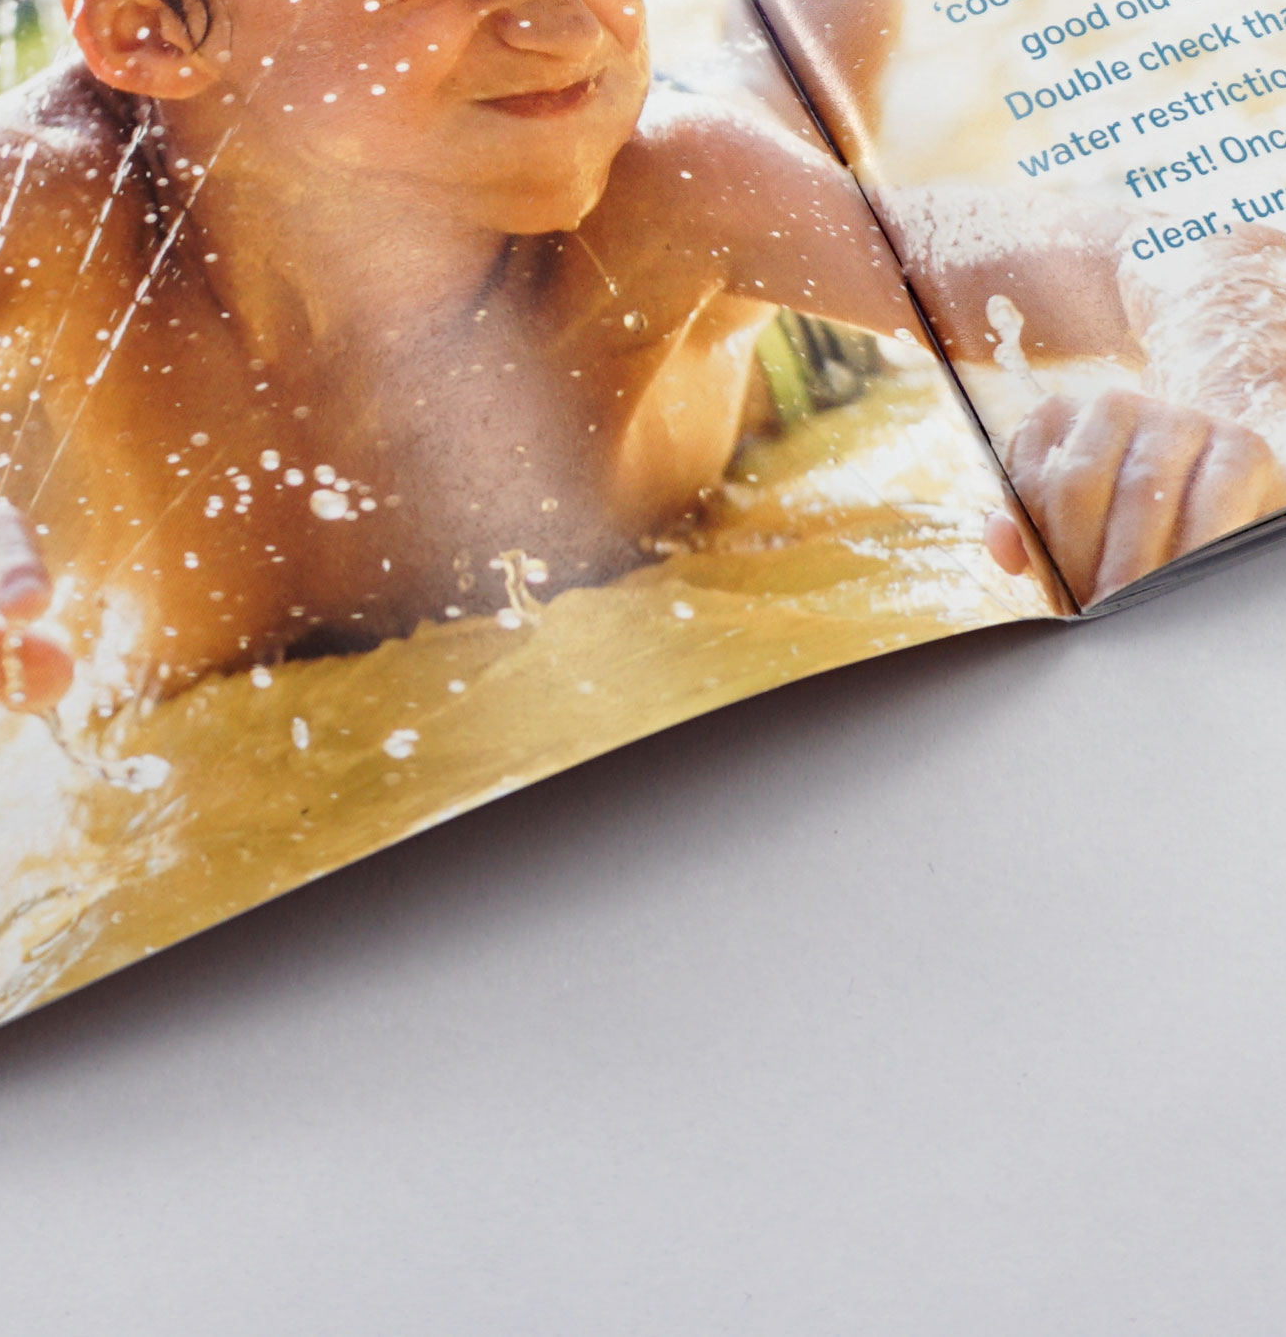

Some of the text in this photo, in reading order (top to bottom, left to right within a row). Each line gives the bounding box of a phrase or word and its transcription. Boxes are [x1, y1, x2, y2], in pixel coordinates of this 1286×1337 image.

[1022, 3, 1110, 60] good
[1005, 61, 1132, 120] Double
[1139, 24, 1240, 71] check
[1019, 121, 1122, 177] water
[1125, 145, 1218, 198] first!
[1132, 211, 1231, 261] clear,
